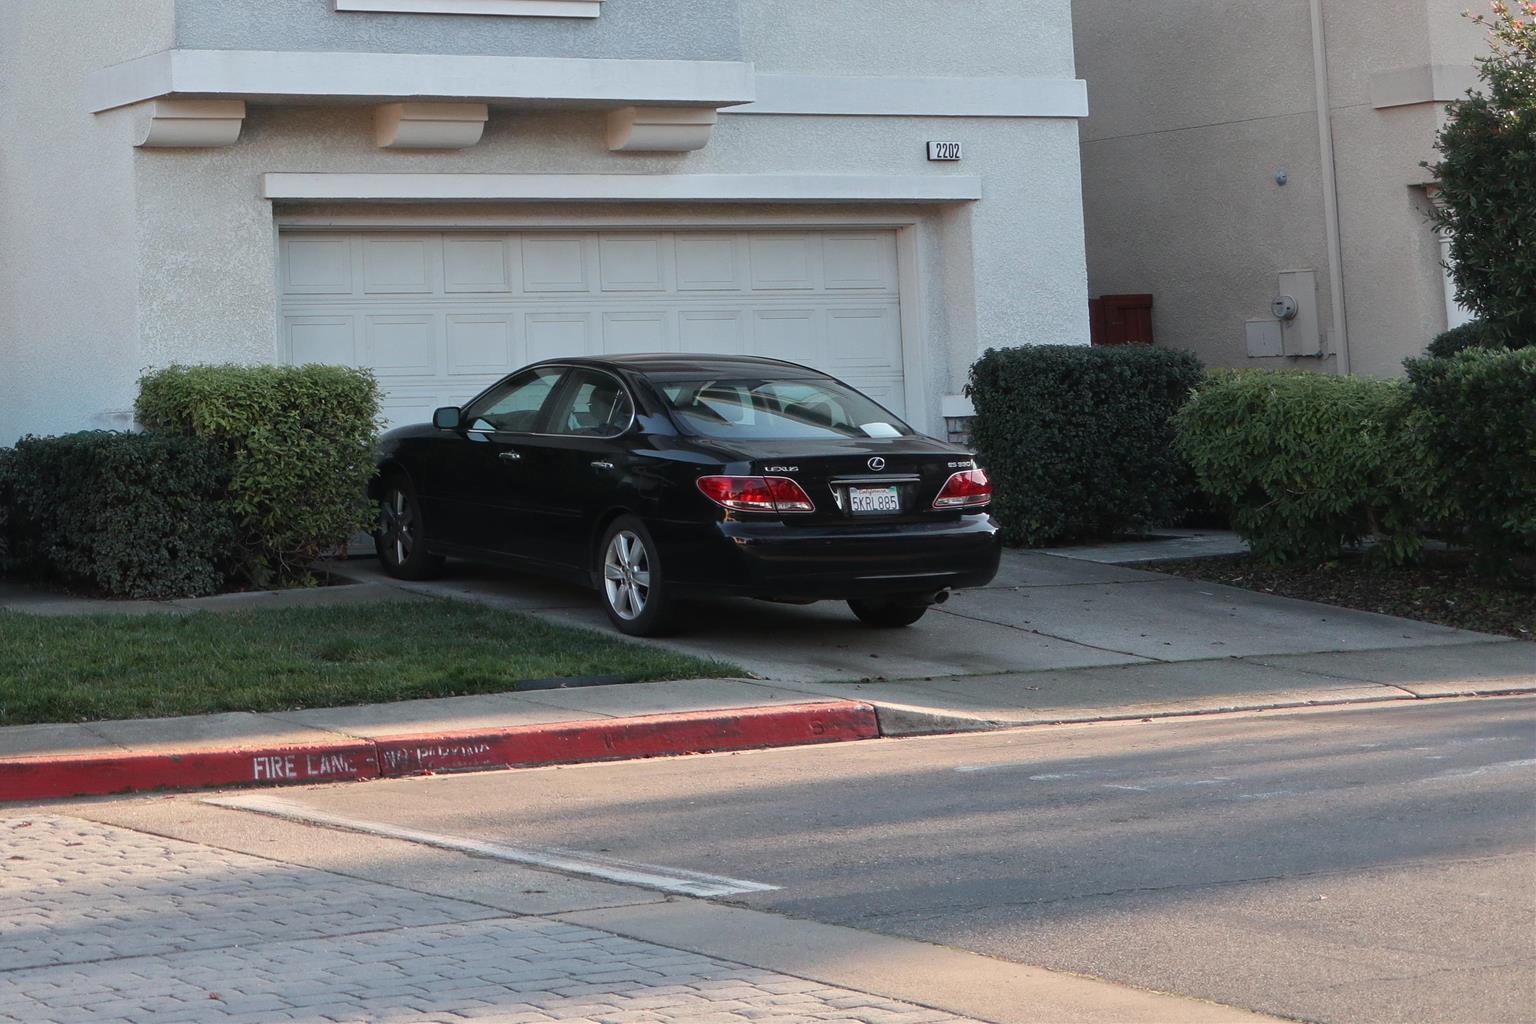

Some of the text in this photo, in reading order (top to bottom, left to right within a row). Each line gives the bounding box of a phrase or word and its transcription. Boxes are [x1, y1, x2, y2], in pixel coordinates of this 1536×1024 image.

[936, 143, 960, 158] 2202
[852, 495, 898, 511] 5KRL885
[253, 755, 297, 779] FIRE
